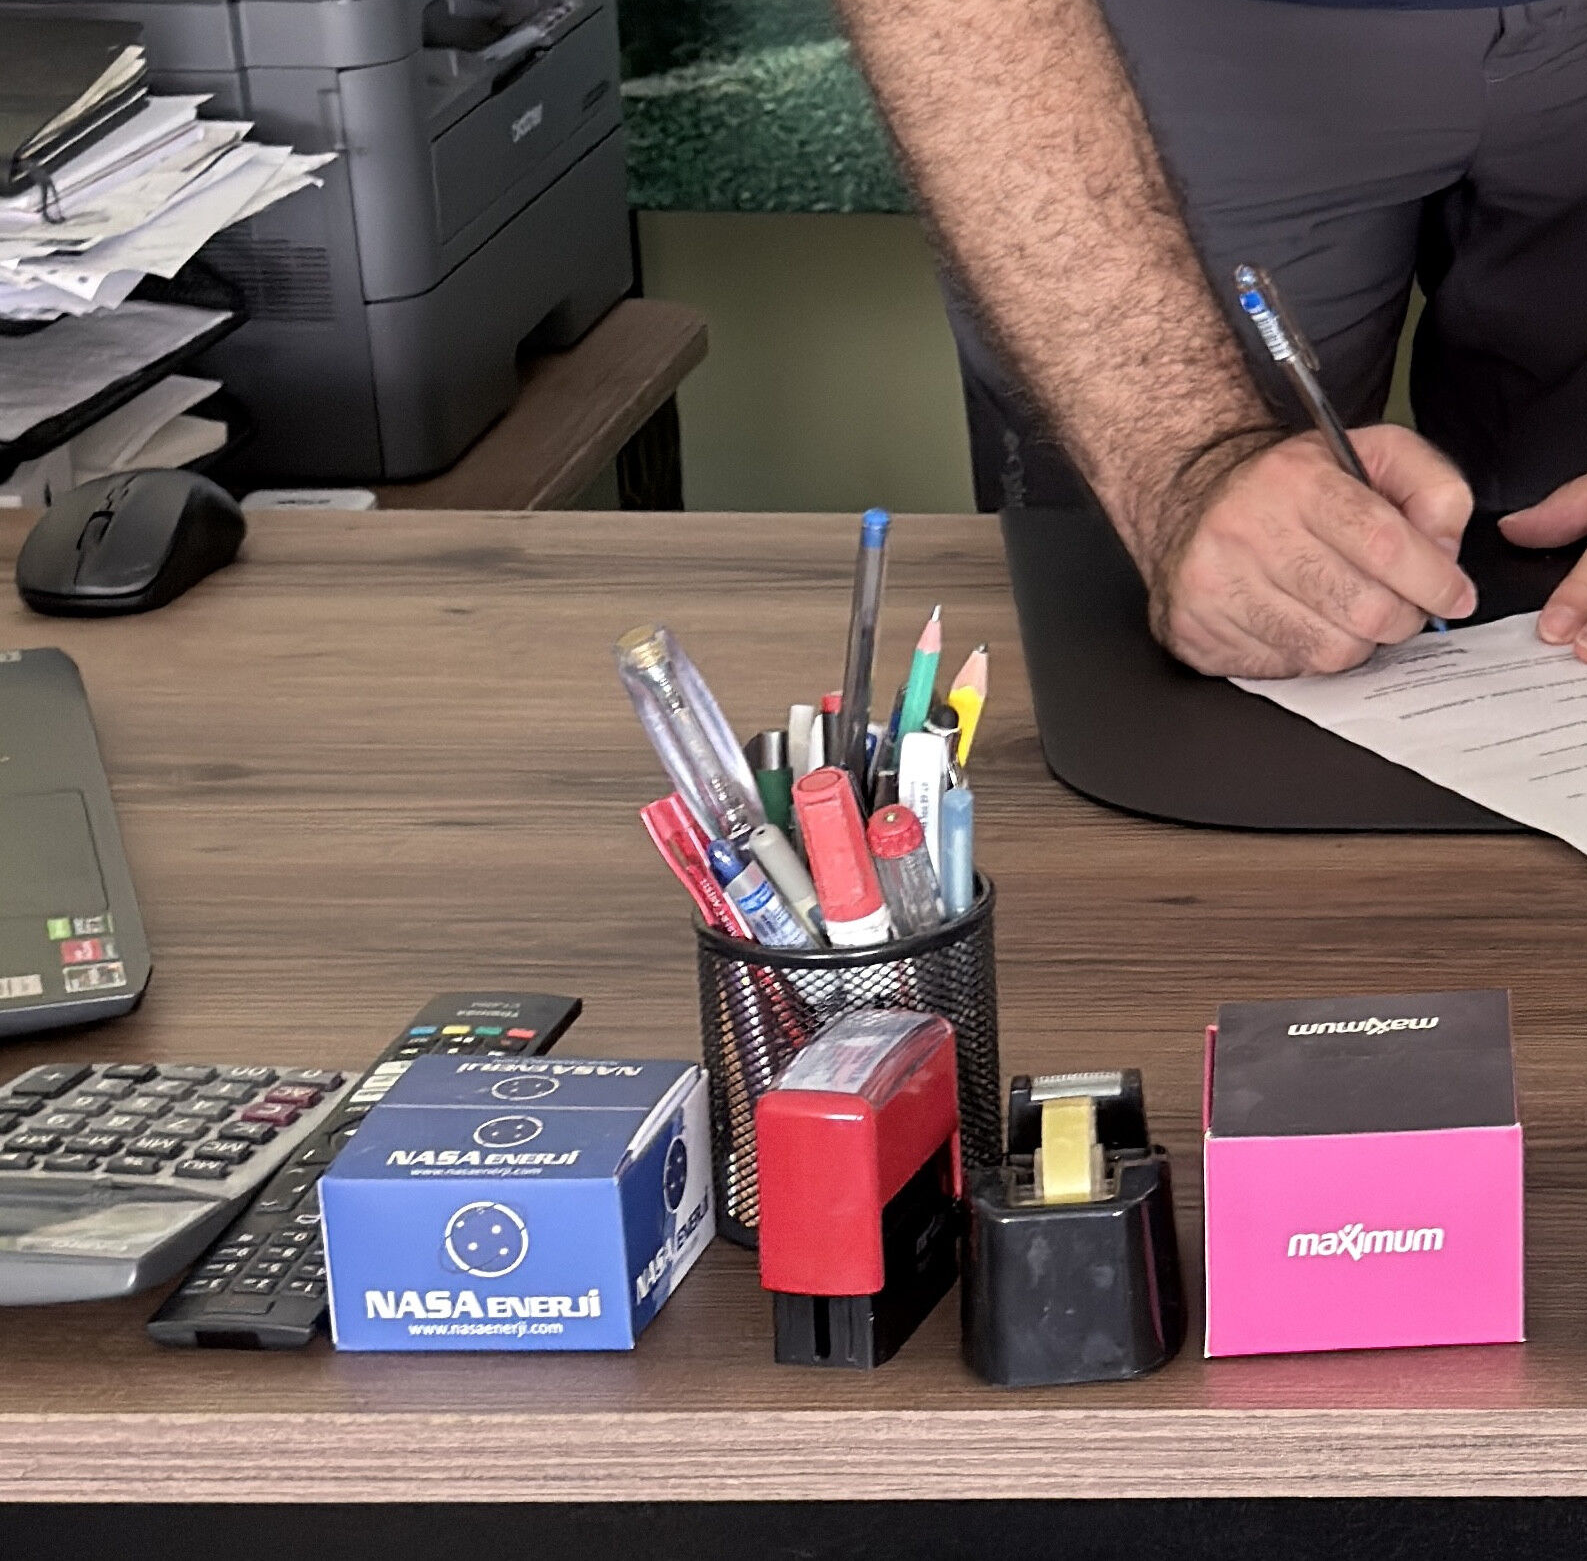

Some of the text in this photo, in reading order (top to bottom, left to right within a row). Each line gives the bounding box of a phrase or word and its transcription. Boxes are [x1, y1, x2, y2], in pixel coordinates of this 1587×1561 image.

[386, 1149, 484, 1166] NASA
[1287, 1222, 1444, 1262] maximum
[365, 1290, 486, 1320] NASA
[407, 1321, 564, 1338] www.nasaenerji.com
